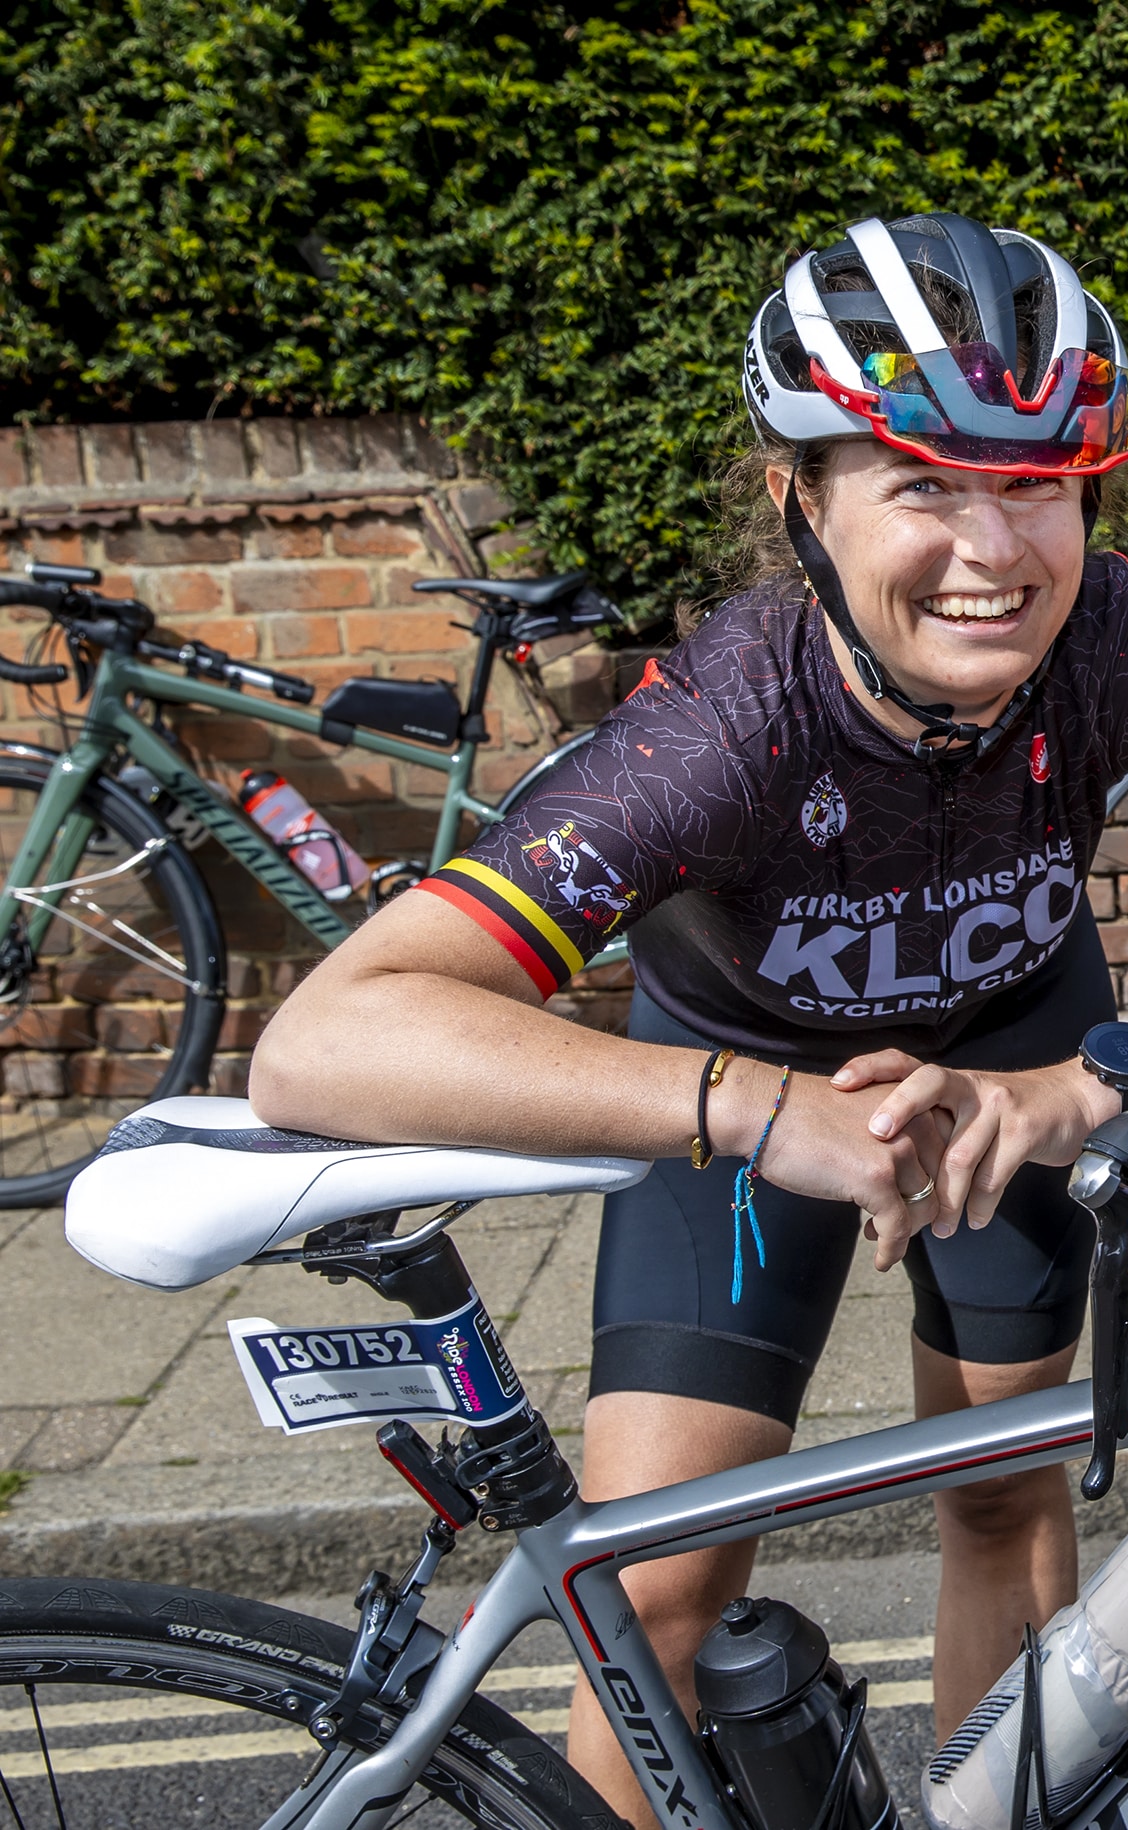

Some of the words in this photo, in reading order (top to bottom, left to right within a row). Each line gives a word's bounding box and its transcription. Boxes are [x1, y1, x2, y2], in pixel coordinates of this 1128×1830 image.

[746, 336, 770, 408] AZER
[780, 892, 911, 924] KIRKBY
[757, 862, 1084, 999] KLCC
[258, 1330, 422, 1372] 130752
[447, 1366, 467, 1396] ESSEX
[196, 1628, 301, 1664] GRAND
